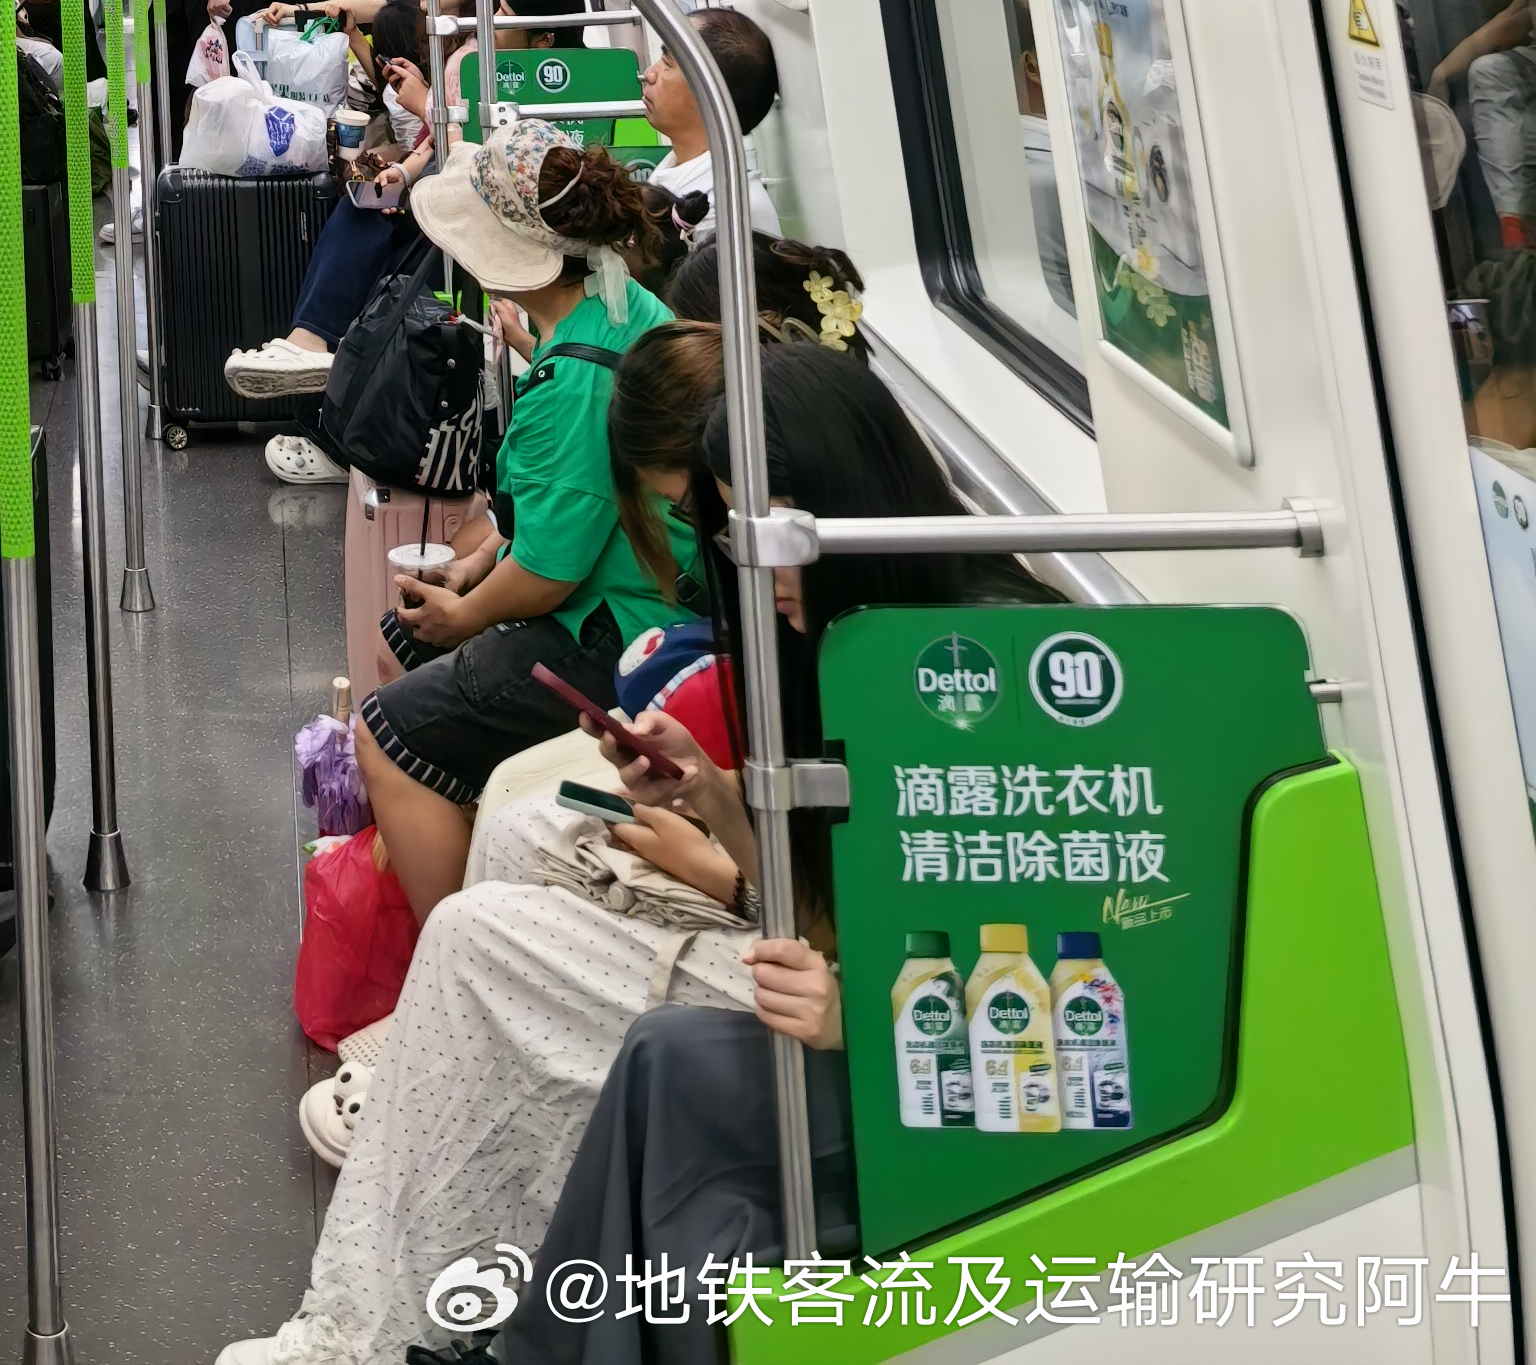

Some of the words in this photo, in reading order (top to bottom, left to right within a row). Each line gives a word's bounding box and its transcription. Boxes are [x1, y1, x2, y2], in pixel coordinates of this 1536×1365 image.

[496, 71, 525, 82] Dettol
[543, 65, 563, 83] 90
[917, 667, 997, 693] Dettol
[1048, 650, 1104, 698] 90
[893, 763, 1163, 817] 滴露洗衣机
[900, 829, 1171, 884] 清洁除菌液
